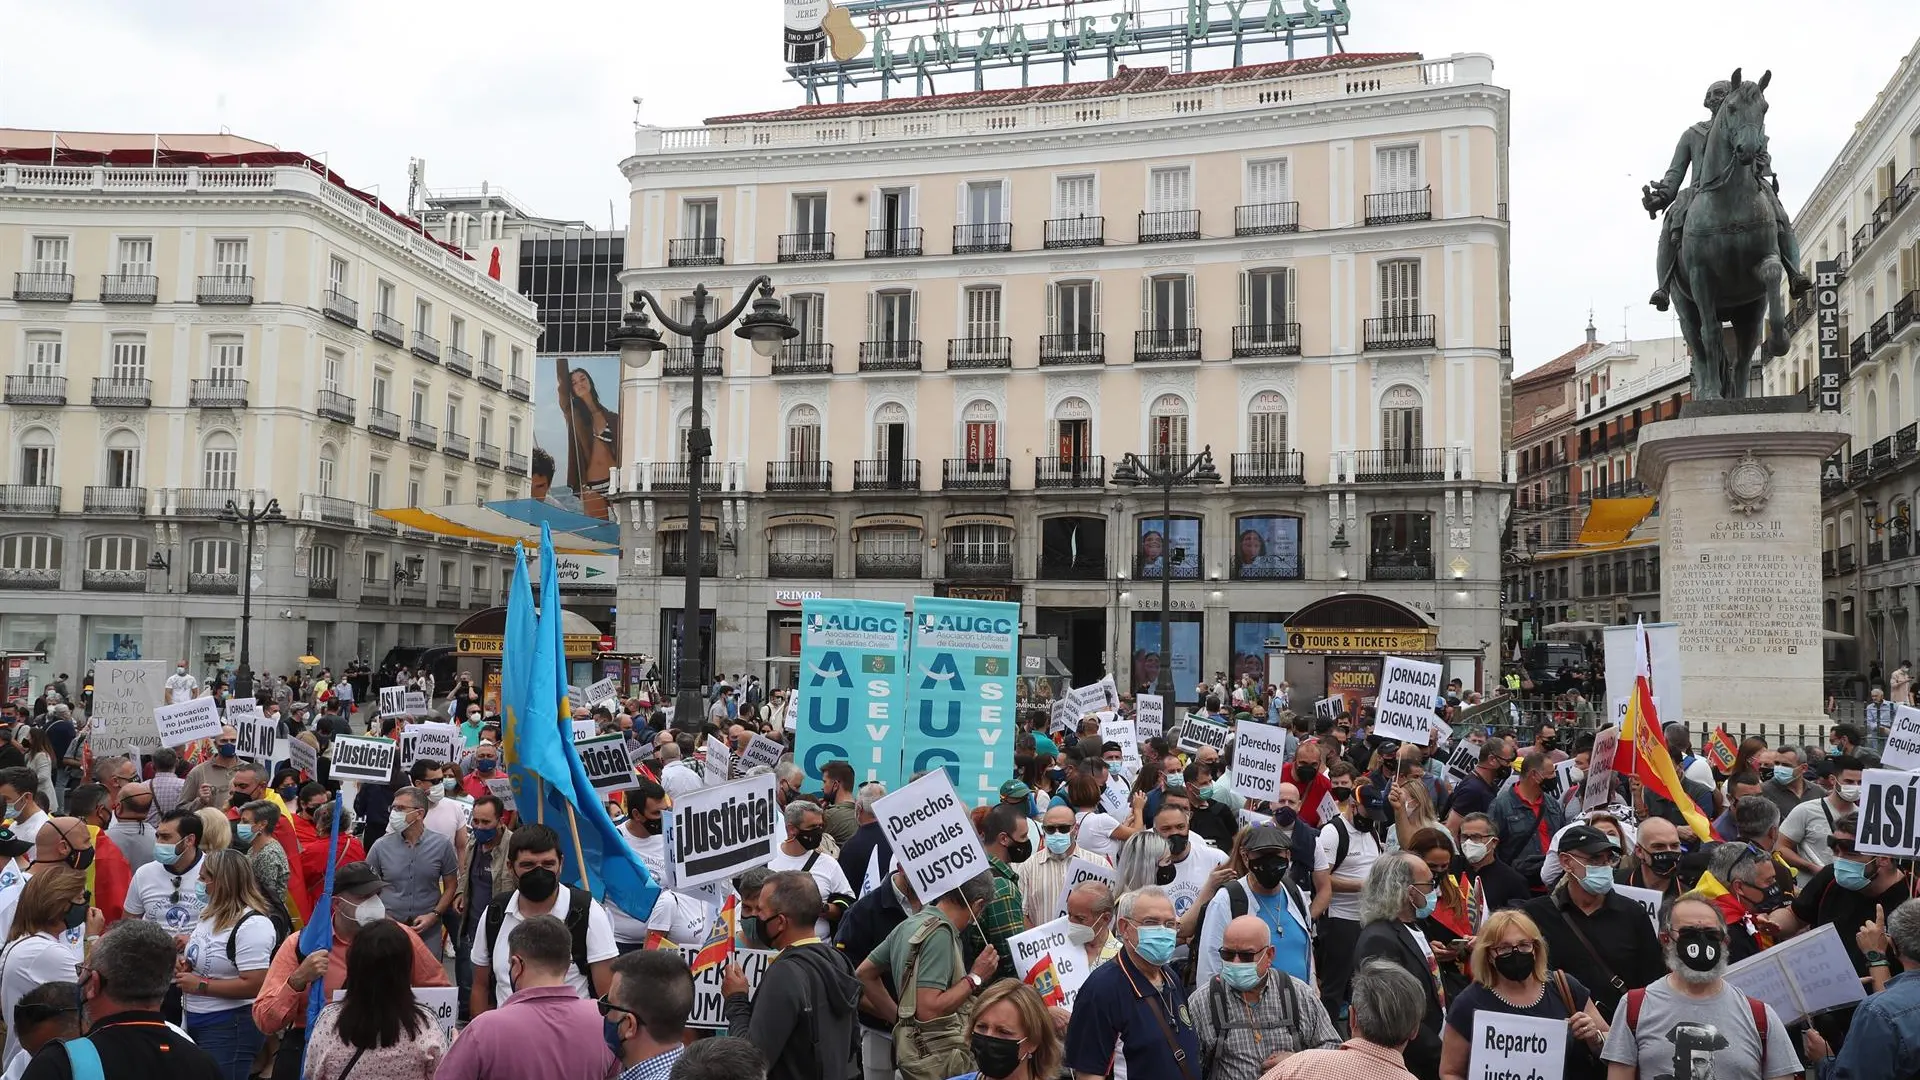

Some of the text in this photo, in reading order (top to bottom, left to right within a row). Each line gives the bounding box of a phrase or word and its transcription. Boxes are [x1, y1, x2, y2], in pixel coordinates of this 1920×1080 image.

[868, 10, 918, 28] SOL
[927, 4, 959, 21] DE
[873, 12, 1130, 72] GONZALEZ
[1817, 272, 1839, 360] HOTEL
[1715, 521, 1781, 531] CARLOS III
[1710, 532, 1727, 540] REY
[1751, 530, 1785, 539] ESPAÑA
[1794, 563, 1803, 571] VI
[775, 590, 823, 600] PRIMOR
[1729, 595, 1772, 603] PROPICIO
[1138, 600, 1197, 609] SEPORA
[1703, 603, 1760, 611] MERCANCIAS
[825, 614, 897, 634] AUGC
[937, 613, 1012, 635] AUGC
[1776, 612, 1794, 620] CON
[824, 630, 895, 642] Asociación Unificada
[936, 630, 1009, 643] Asociación Unificada
[1744, 629, 1789, 637] MEDIANTE
[472, 640, 496, 650] TOURS
[825, 638, 891, 650] de Guardias Civiles
[936, 639, 1004, 651] de Guardias Civiles
[1307, 636, 1398, 648] TOURS & TICKETS
[1716, 645, 1725, 653] EL
[1734, 643, 1755, 653] AÑO
[1749, 637, 1762, 645] DE
[1768, 637, 1818, 646] HOSPITALES
[111, 668, 146, 684] POR
[1333, 672, 1375, 685] SHORTA
[1389, 666, 1437, 689] JORNADA
[117, 687, 134, 698] UN
[396, 689, 405, 712] NO
[1386, 688, 1432, 710] LABORAL
[162, 705, 210, 722] La vocación
[229, 703, 254, 716] JORNADA
[1139, 700, 1162, 711] JORNADA
[1332, 698, 1343, 715] NO
[93, 715, 153, 729] JUSTO DE
[166, 713, 210, 729] no justifica
[1139, 713, 1161, 724] LABORAL
[169, 720, 219, 737] explotación.
[1105, 727, 1129, 737] Reparto
[1180, 720, 1227, 749] ¡Justicia!
[236, 719, 275, 757] ASÍ, NO
[420, 733, 450, 744] JORNADA
[1123, 740, 1131, 748] de
[1238, 733, 1281, 754] ¡Derechos
[332, 740, 394, 770] ¡Justicia!
[418, 746, 448, 757] LABORAL
[751, 739, 779, 756] JORNADA
[1238, 753, 1277, 773] laborales
[1235, 772, 1275, 793] JUSTOS!
[887, 793, 954, 841] ¡Derechos
[675, 788, 775, 864] ¡Justicia!
[901, 821, 964, 862] laborales
[916, 843, 977, 893] JUSTOS!
[1017, 931, 1066, 960] Reparto
[1057, 957, 1074, 975] de
[438, 1001, 452, 1019] de
[1485, 1025, 1548, 1058] Reparto
